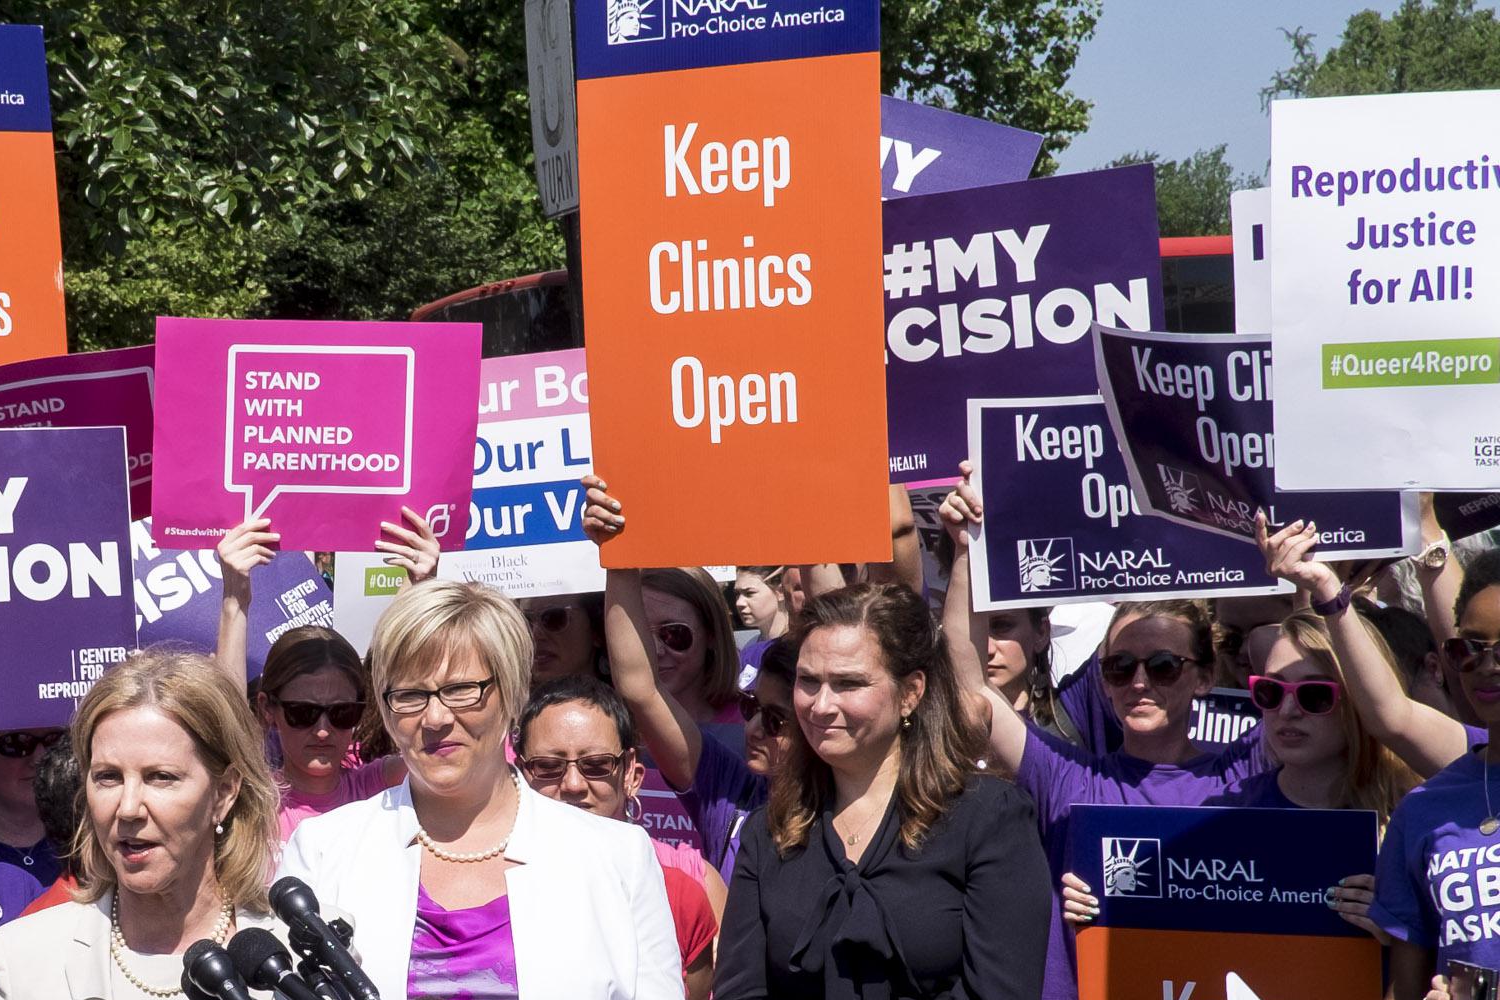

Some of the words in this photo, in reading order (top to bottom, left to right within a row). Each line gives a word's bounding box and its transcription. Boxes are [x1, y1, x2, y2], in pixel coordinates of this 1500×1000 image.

[671, 15, 766, 38] Pro-Choice
[771, 6, 845, 28] America
[664, 122, 791, 207] Keep
[541, 149, 573, 208] TURN
[1346, 211, 1476, 251] Justice
[883, 223, 1050, 299] #MY
[648, 235, 812, 315] Clinics
[1347, 269, 1400, 305] for
[1408, 265, 1473, 302] All!
[1131, 345, 1216, 410] Keep
[1330, 351, 1492, 379] #Queer4Repro
[245, 371, 321, 391] STAND
[244, 399, 303, 417] WITH
[670, 355, 798, 444] Open
[244, 426, 353, 445] PLANNED
[1015, 412, 1104, 468] Keep
[243, 452, 400, 472] PARENTHOOD
[889, 453, 927, 473] HEALTH
[491, 554, 528, 569] Black
[1079, 547, 1171, 574] NARAL
[462, 568, 522, 584] Women's
[1080, 572, 1171, 589] Pro-Choice
[1175, 566, 1245, 584] America
[281, 578, 319, 606] CENTER
[287, 598, 311, 617] FOR
[79, 647, 126, 664] CENTER
[80, 664, 104, 680] FOR
[643, 812, 697, 832] STAN
[1167, 857, 1264, 882] NARAL
[1168, 883, 1264, 902] Pro-Choice
[1439, 911, 1500, 947] ASK
